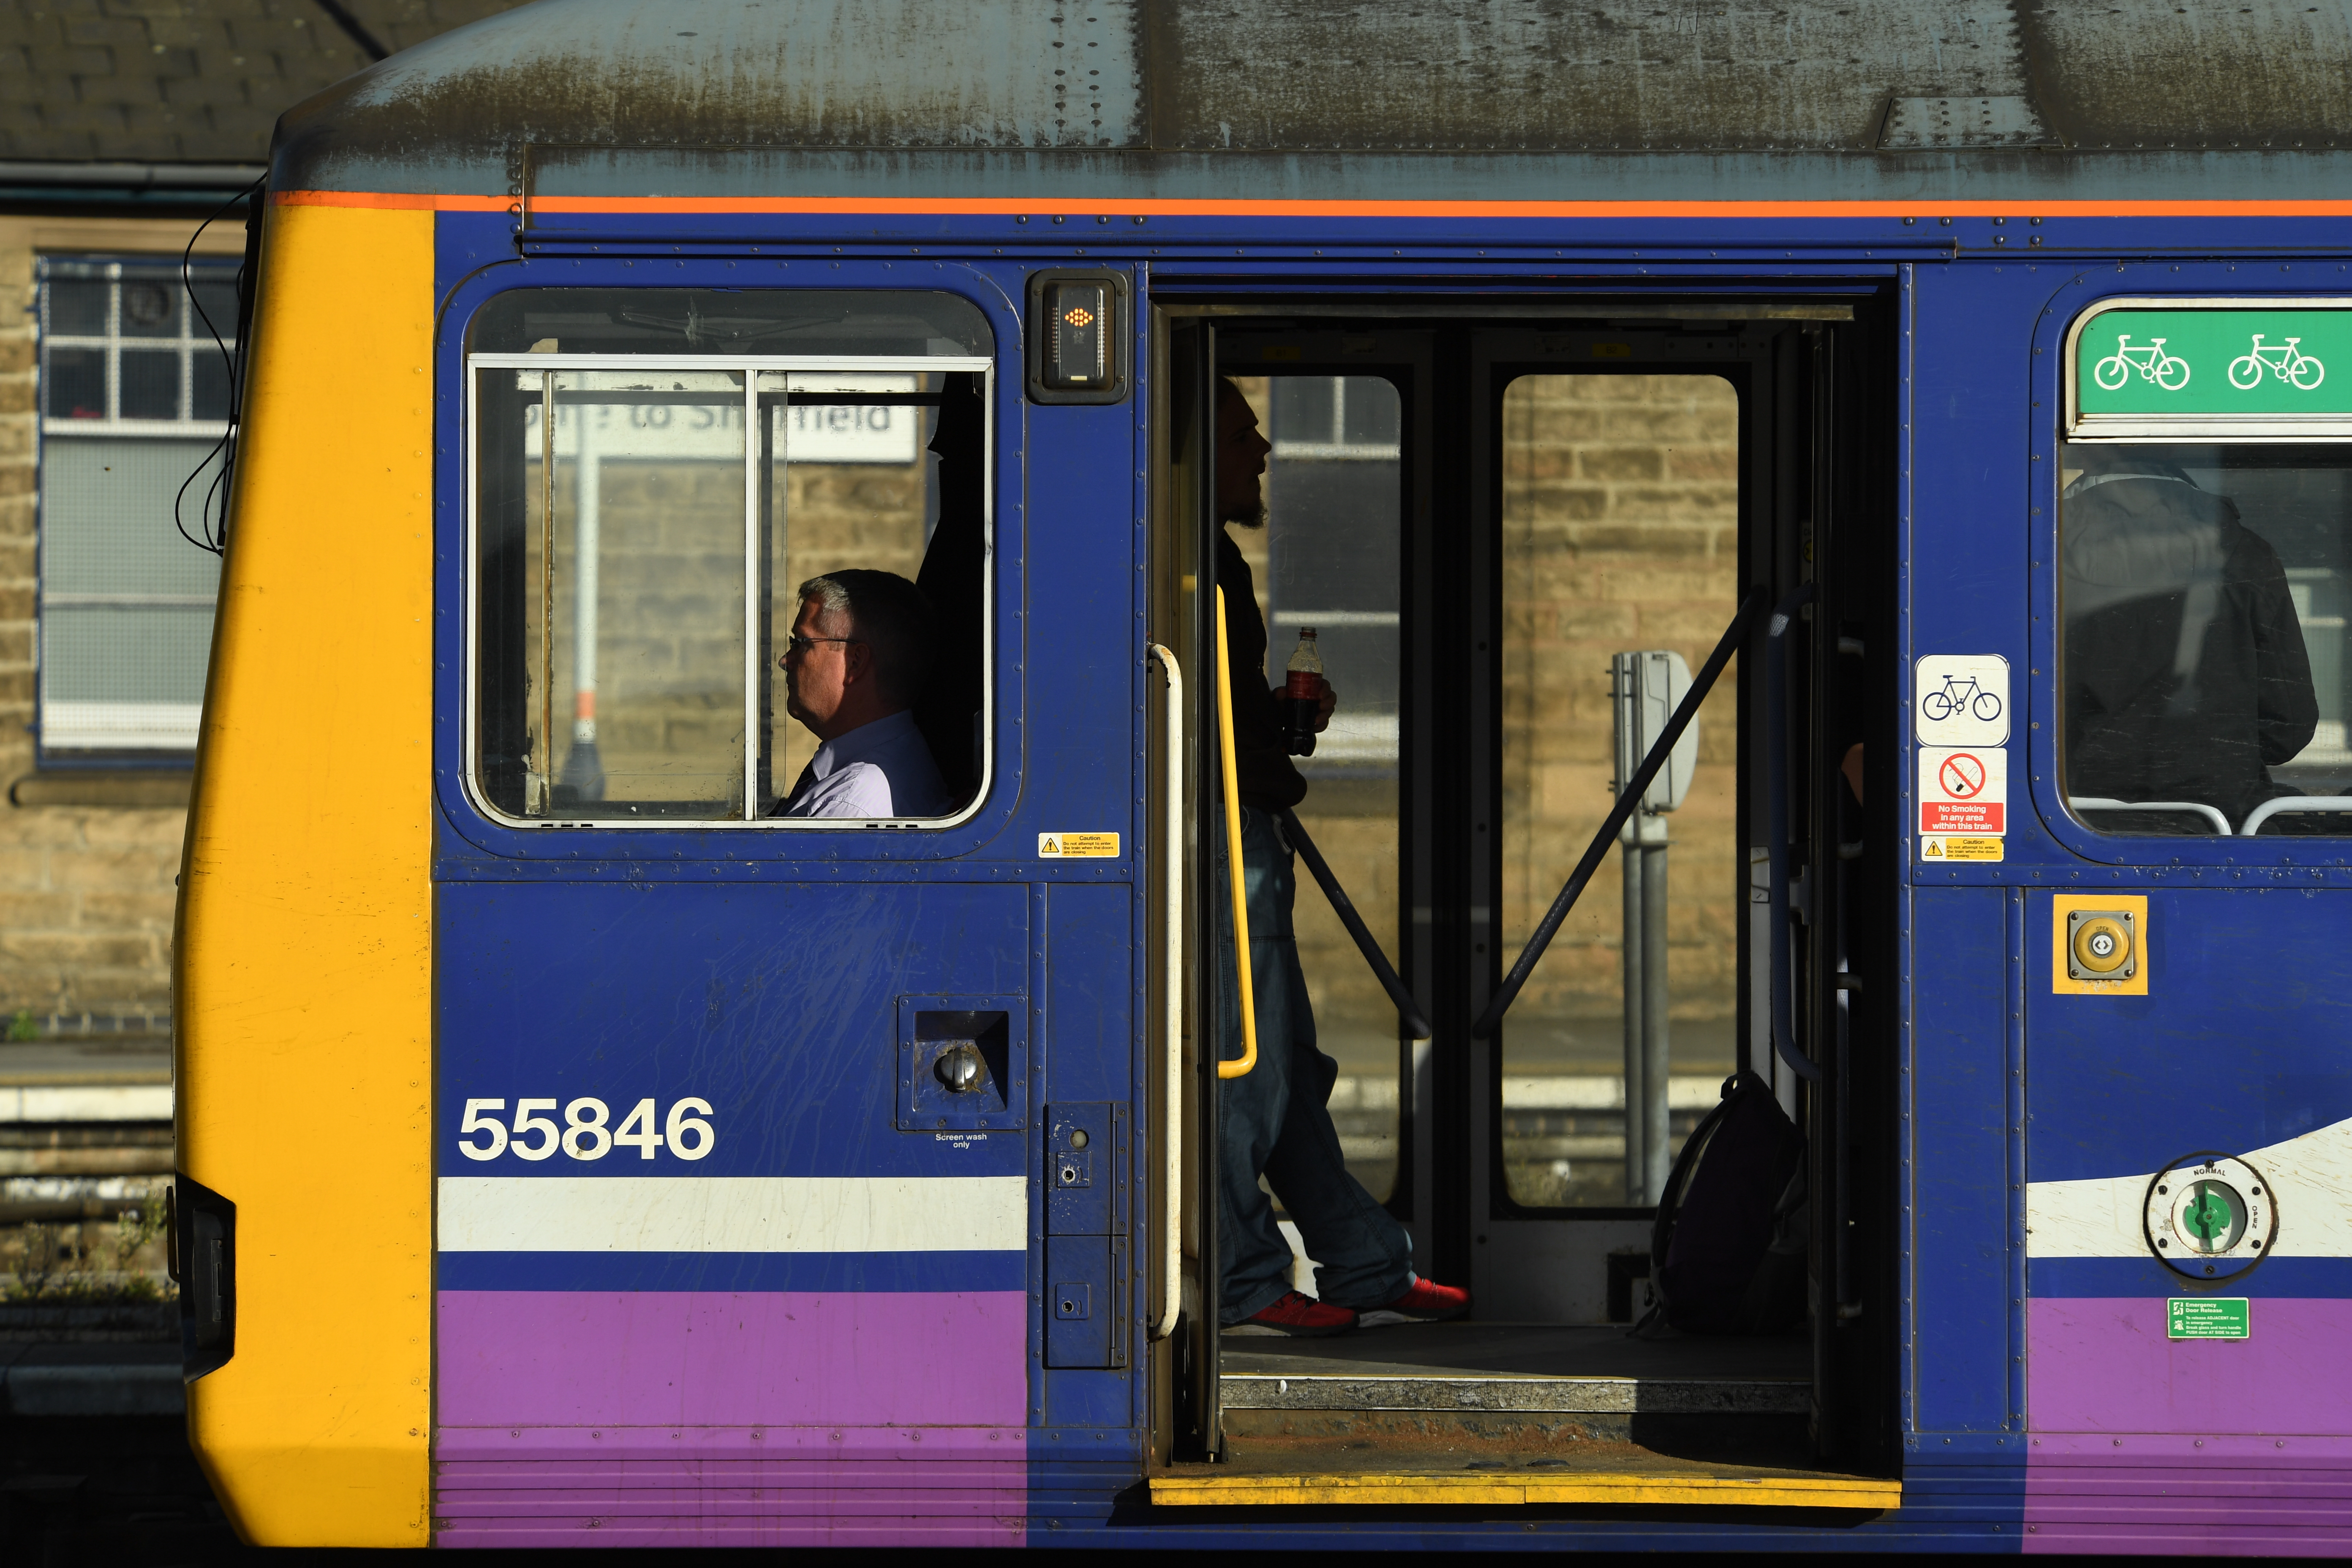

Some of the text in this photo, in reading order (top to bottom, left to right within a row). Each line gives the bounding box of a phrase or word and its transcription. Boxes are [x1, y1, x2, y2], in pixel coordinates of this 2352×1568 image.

[1952, 805, 1987, 814] Smoking
[458, 1097, 715, 1161] 55846
[953, 1141, 970, 1149] only
[2194, 1168, 2226, 1176] NORMAL
